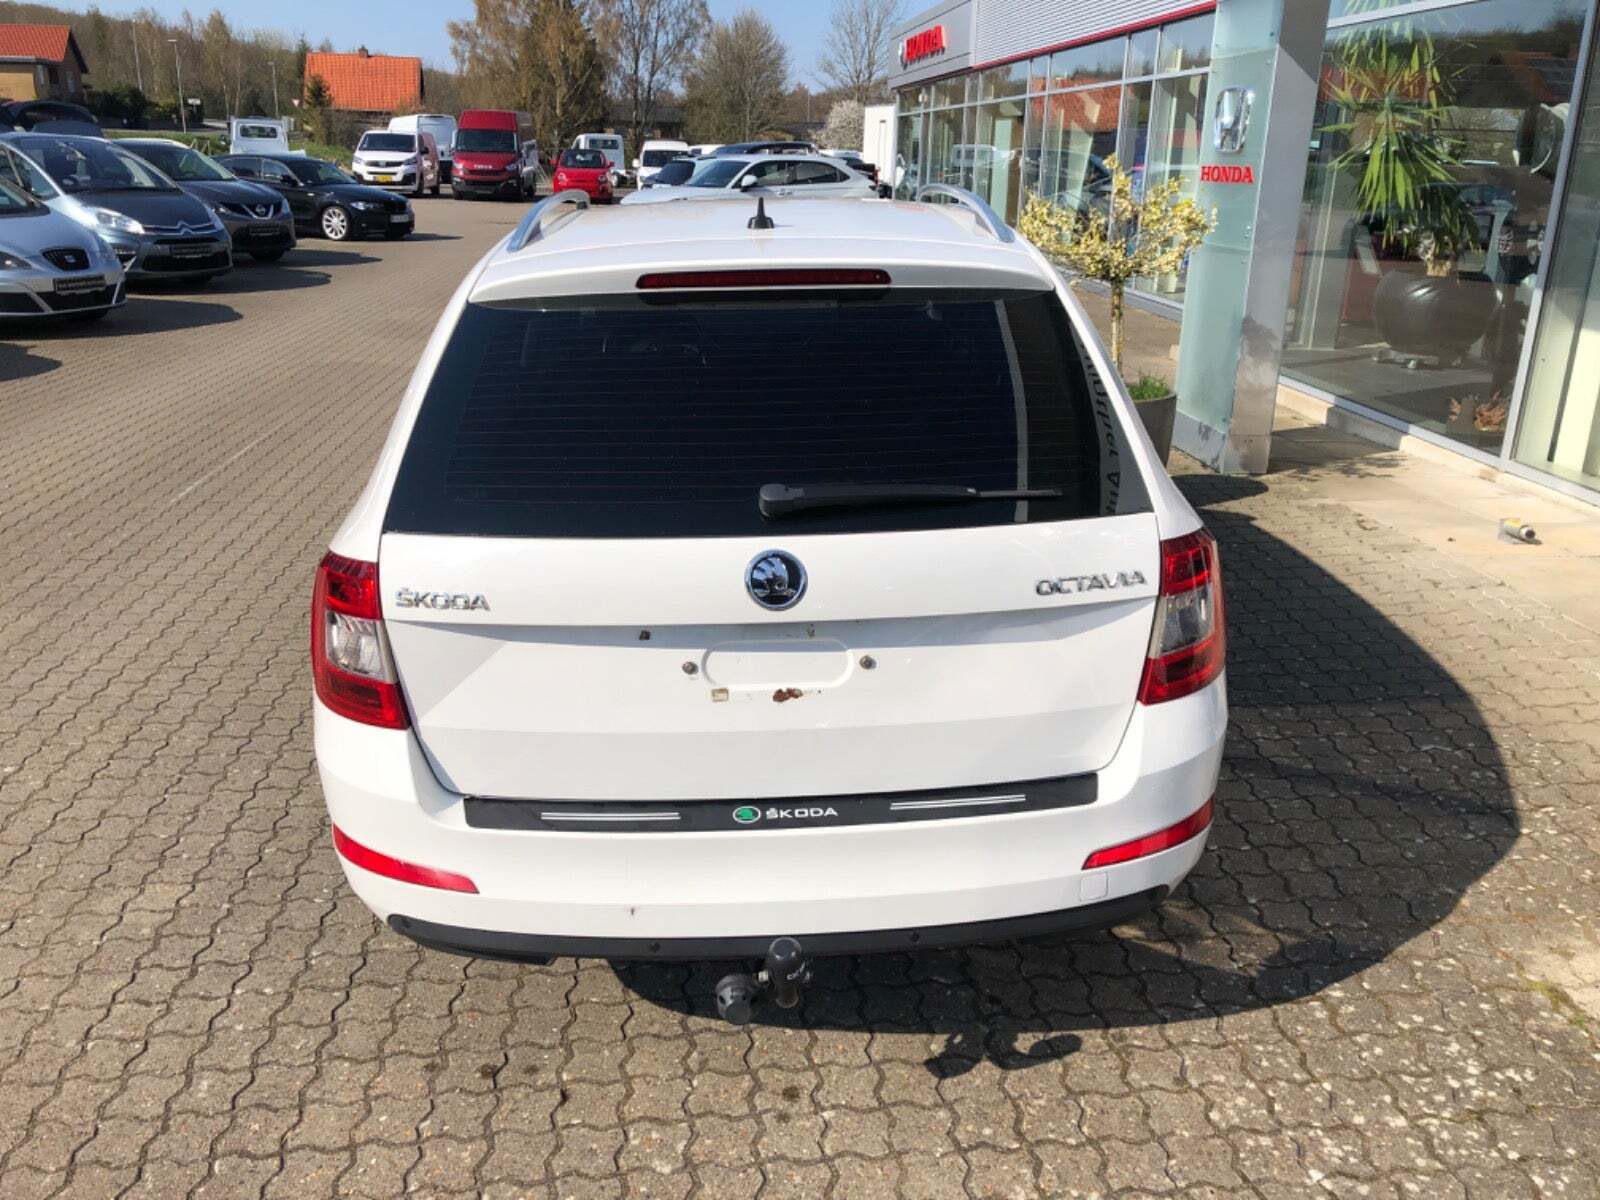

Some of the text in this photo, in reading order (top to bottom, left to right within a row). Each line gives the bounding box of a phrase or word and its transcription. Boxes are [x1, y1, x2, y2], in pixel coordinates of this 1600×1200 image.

[903, 25, 946, 63] HONDA
[1200, 165, 1254, 184] HONDA
[1035, 570, 1147, 597] OCTAVIA
[395, 587, 491, 612] ŠKODA
[766, 807, 839, 820] ŠKODA
